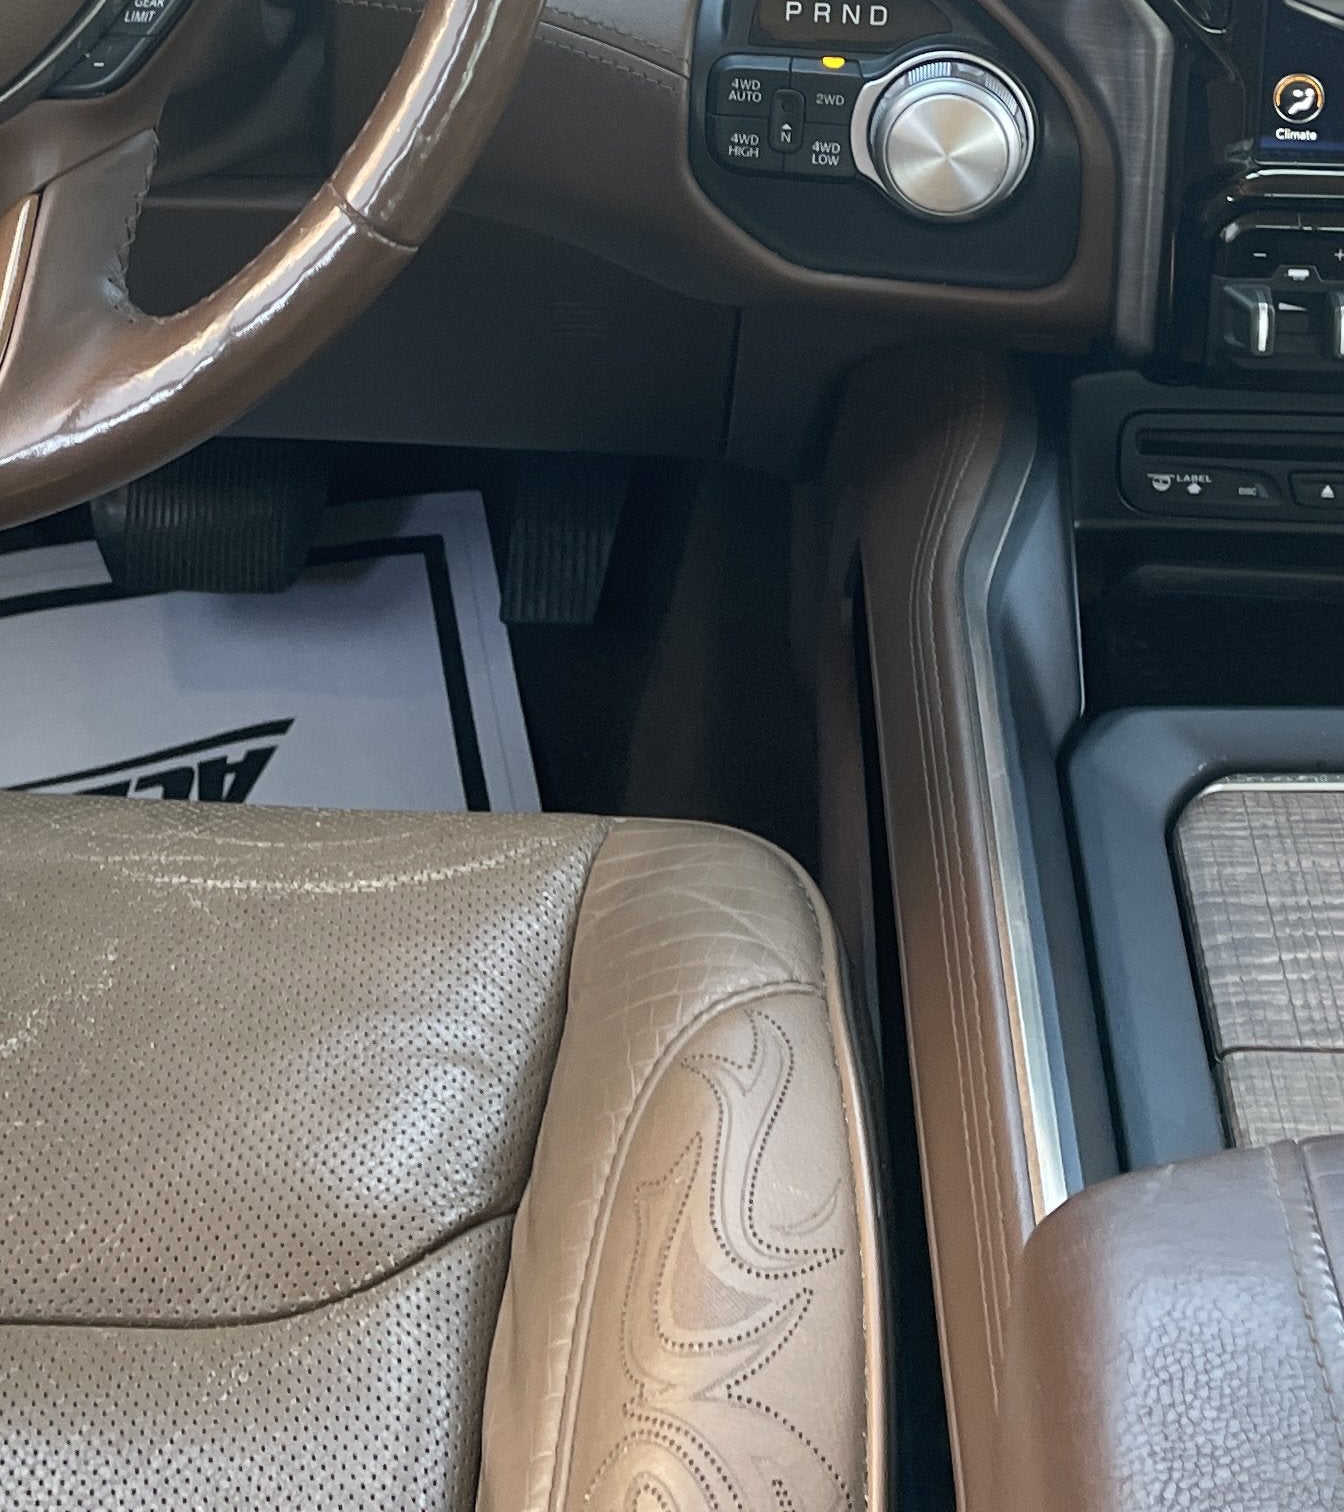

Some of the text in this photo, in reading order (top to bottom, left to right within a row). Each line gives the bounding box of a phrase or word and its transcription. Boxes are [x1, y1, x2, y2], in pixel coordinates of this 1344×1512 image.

[124, 10, 156, 23] LIMIT
[785, 1, 888, 26] P R N D
[731, 78, 761, 91] 4WD
[728, 90, 762, 103] AUTO
[816, 94, 845, 106] 2WD
[730, 133, 759, 147] 4WD
[781, 131, 791, 143] N
[1275, 128, 1318, 142] Climate
[728, 145, 759, 158] HIGH
[812, 142, 841, 155] 4WD
[811, 153, 840, 166] LOW
[1176, 474, 1212, 483] LABEL
